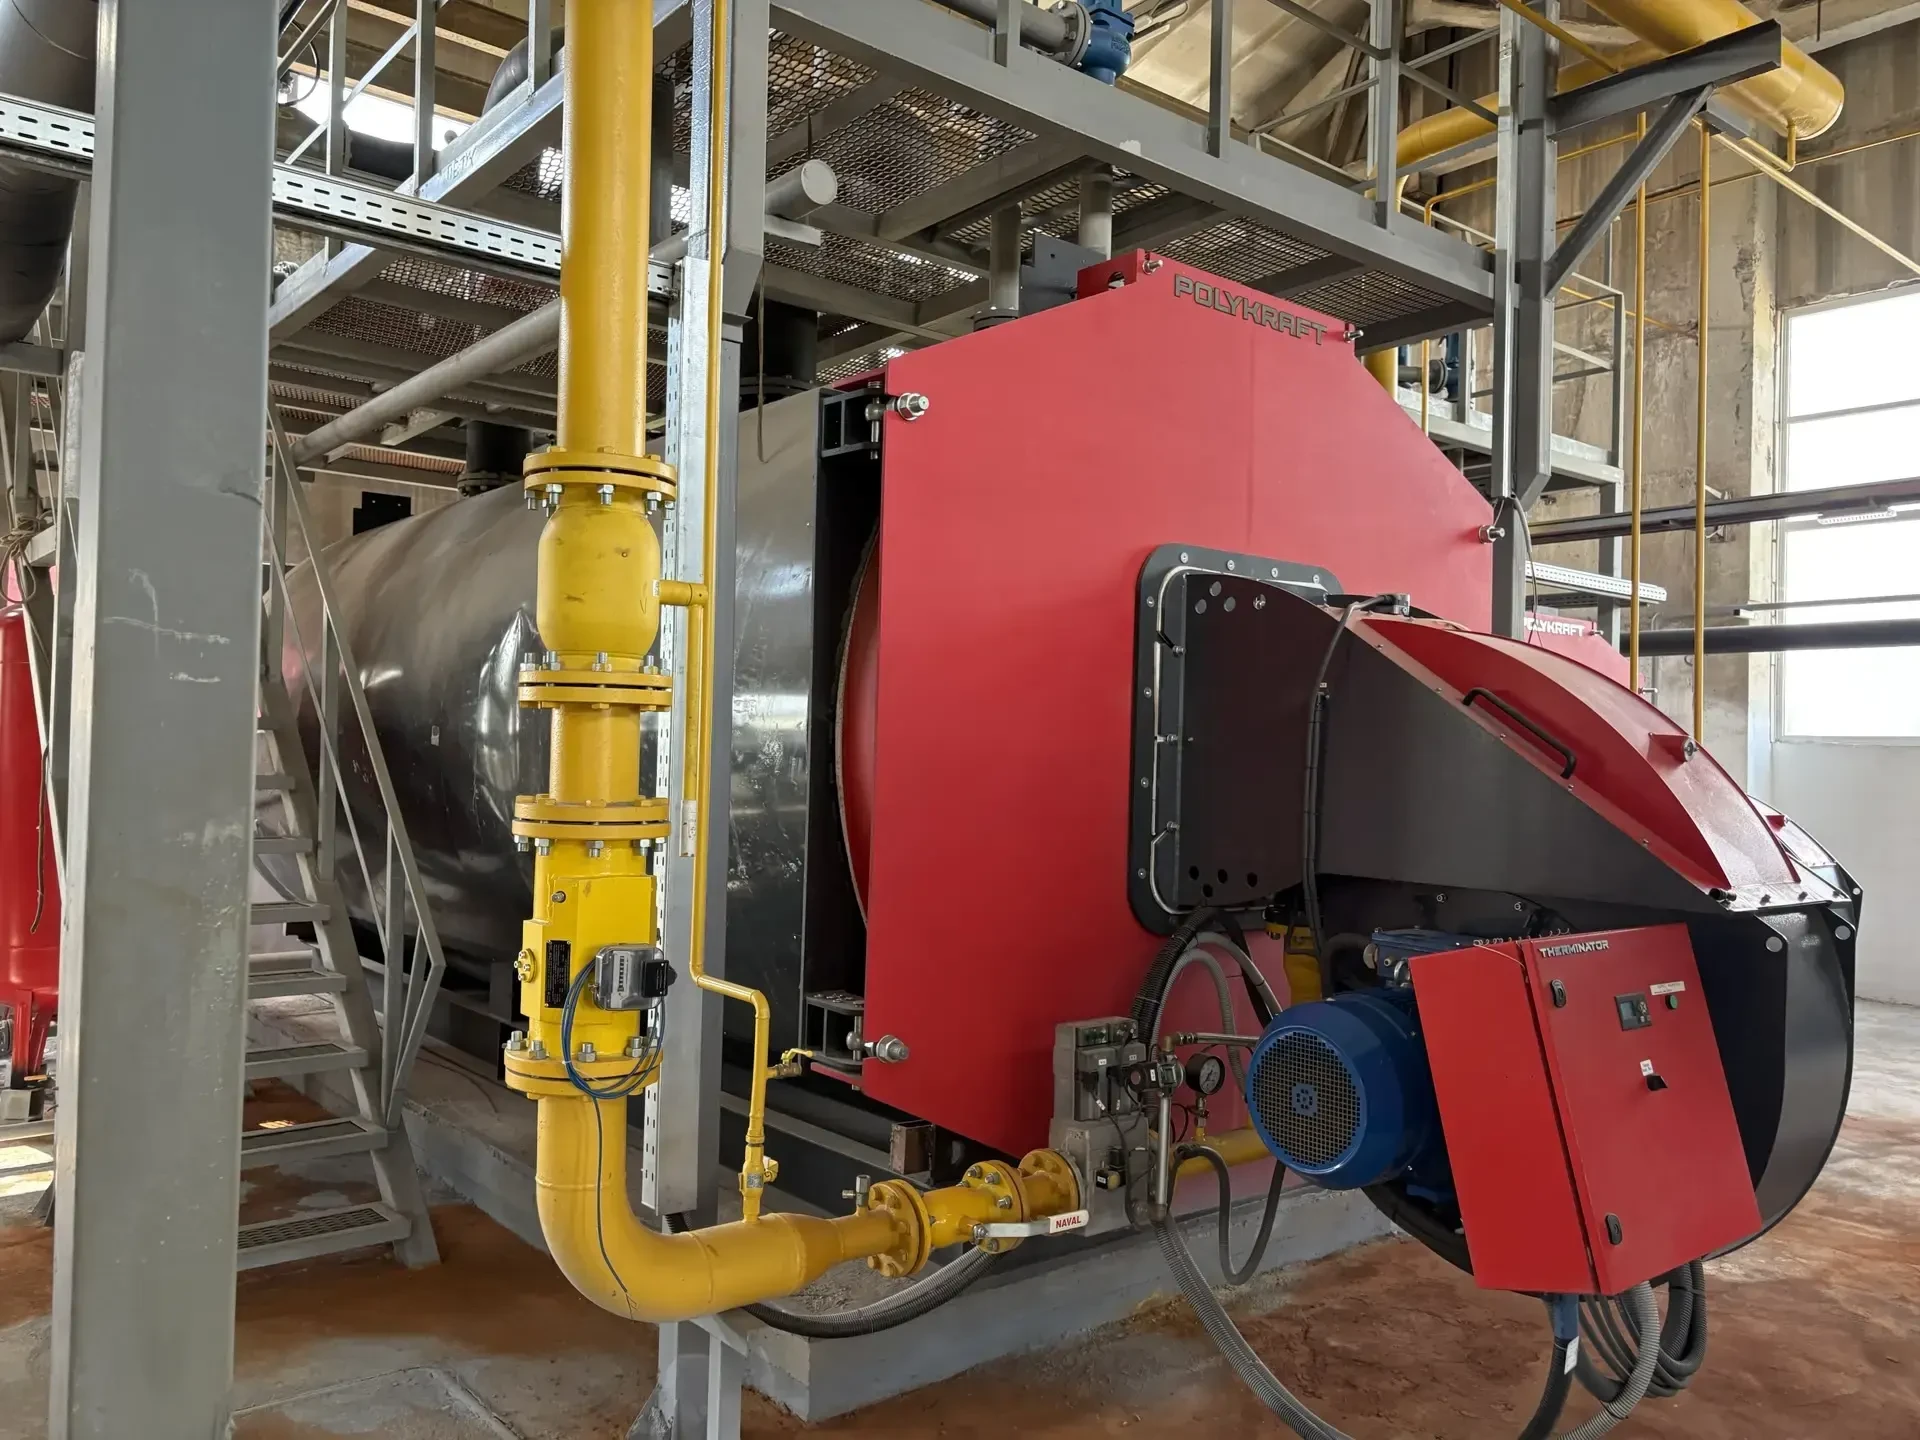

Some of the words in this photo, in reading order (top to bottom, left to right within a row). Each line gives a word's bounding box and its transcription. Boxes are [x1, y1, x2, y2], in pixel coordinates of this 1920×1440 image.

[1174, 273, 1328, 345] POLYKRAFT
[1539, 939, 1610, 958] THERMINATOR
[1055, 1215, 1082, 1229] NAVAL
